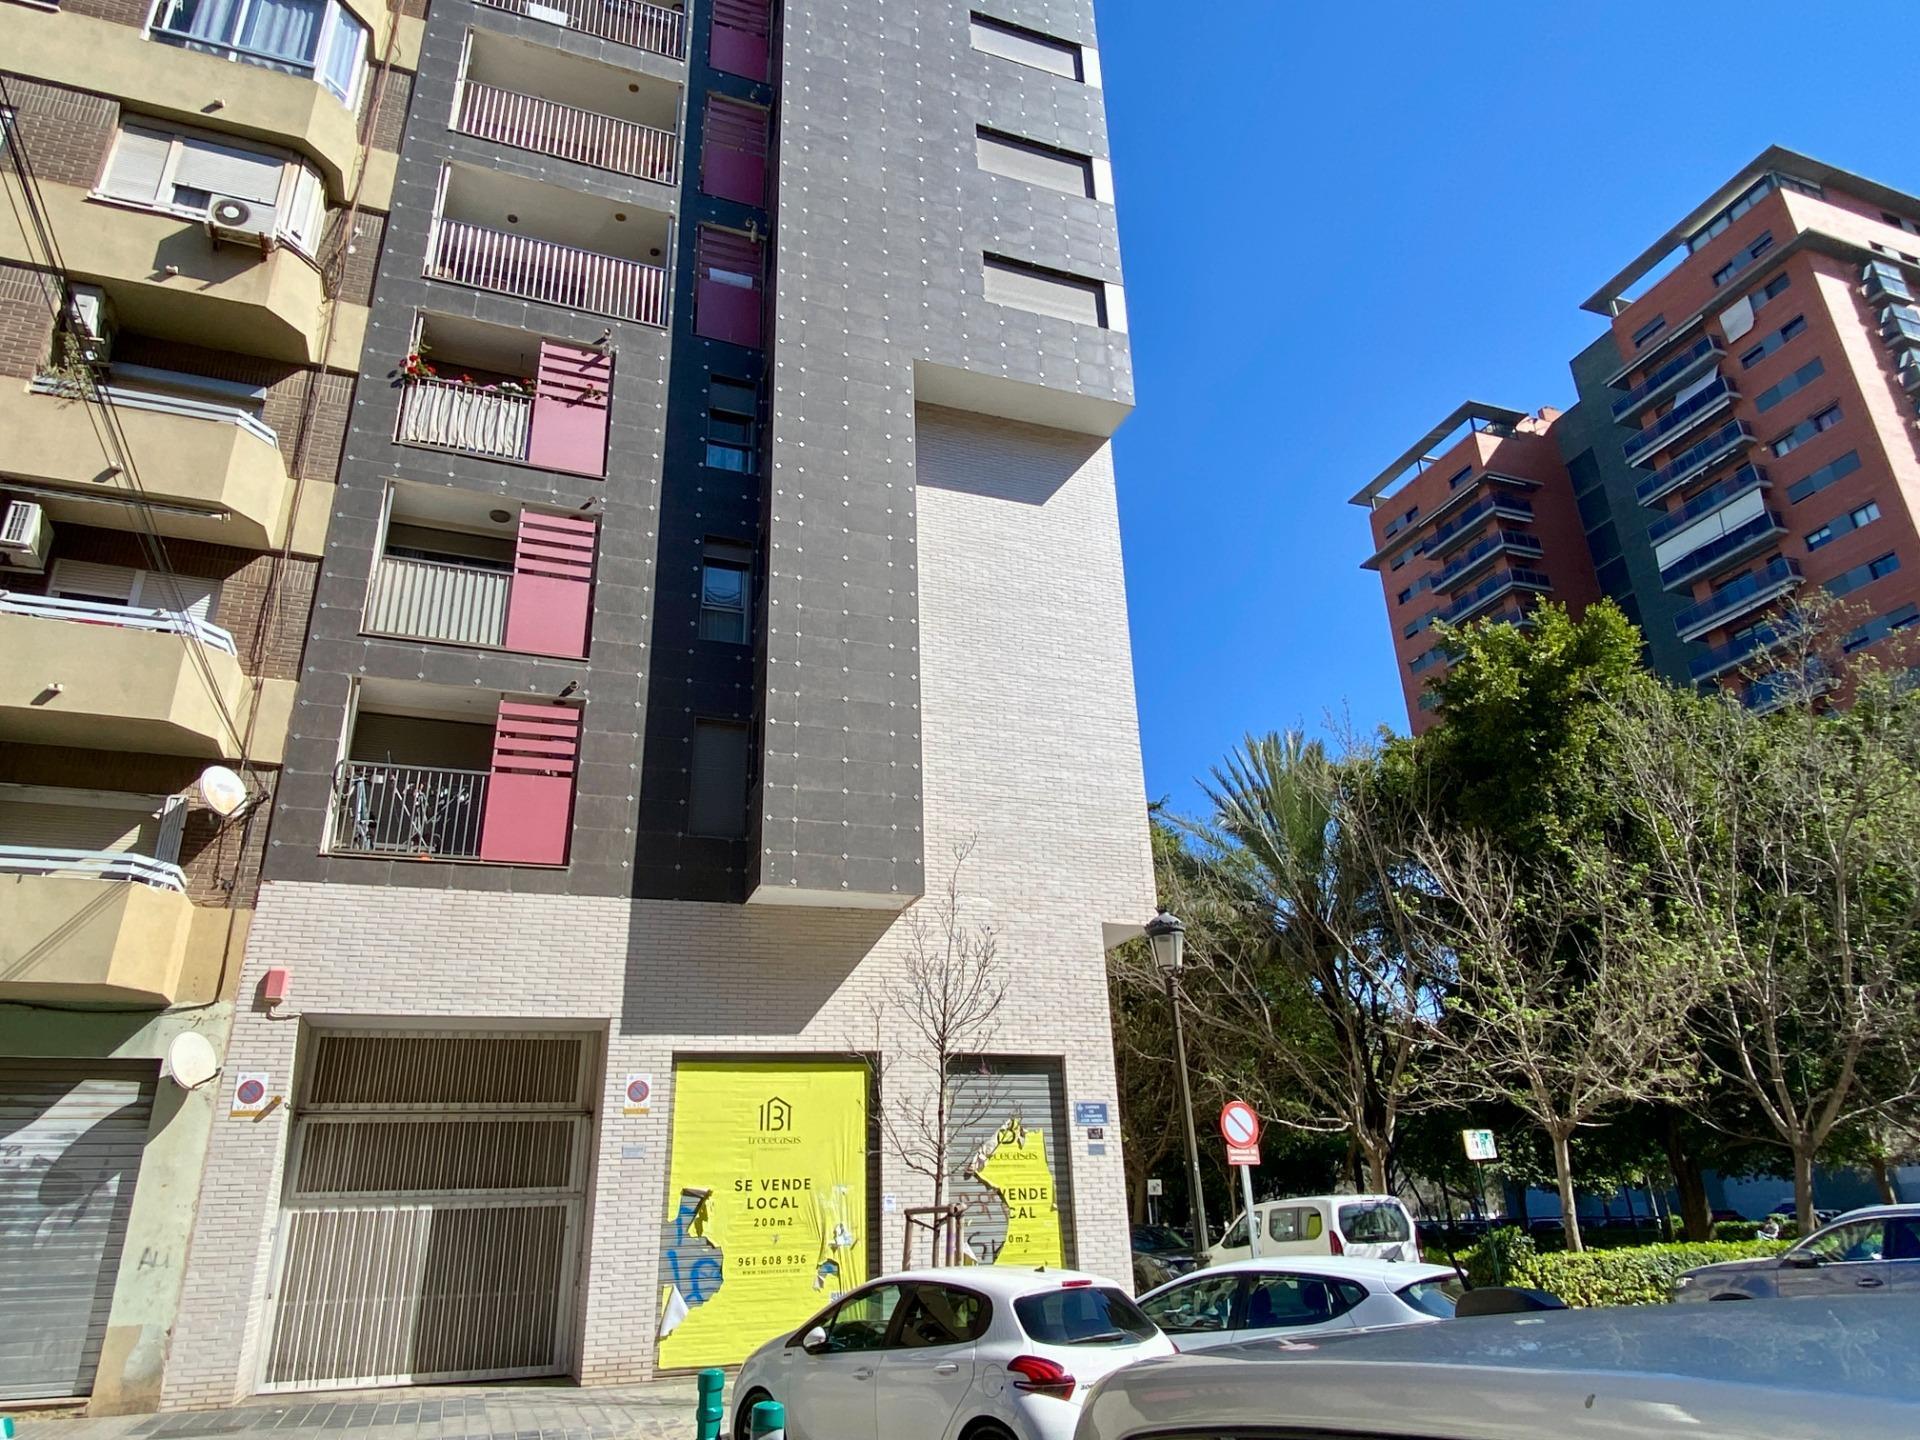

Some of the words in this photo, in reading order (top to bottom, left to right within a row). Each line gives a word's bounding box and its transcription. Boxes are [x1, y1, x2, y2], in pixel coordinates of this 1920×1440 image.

[734, 1179, 753, 1192] SE
[760, 1178, 811, 1191] VENDE
[747, 1196, 799, 1210] LOCAL
[753, 1217, 793, 1227] 200m2
[738, 1256, 756, 1267] 961
[761, 1255, 782, 1266] 608
[787, 1254, 807, 1265] 936
